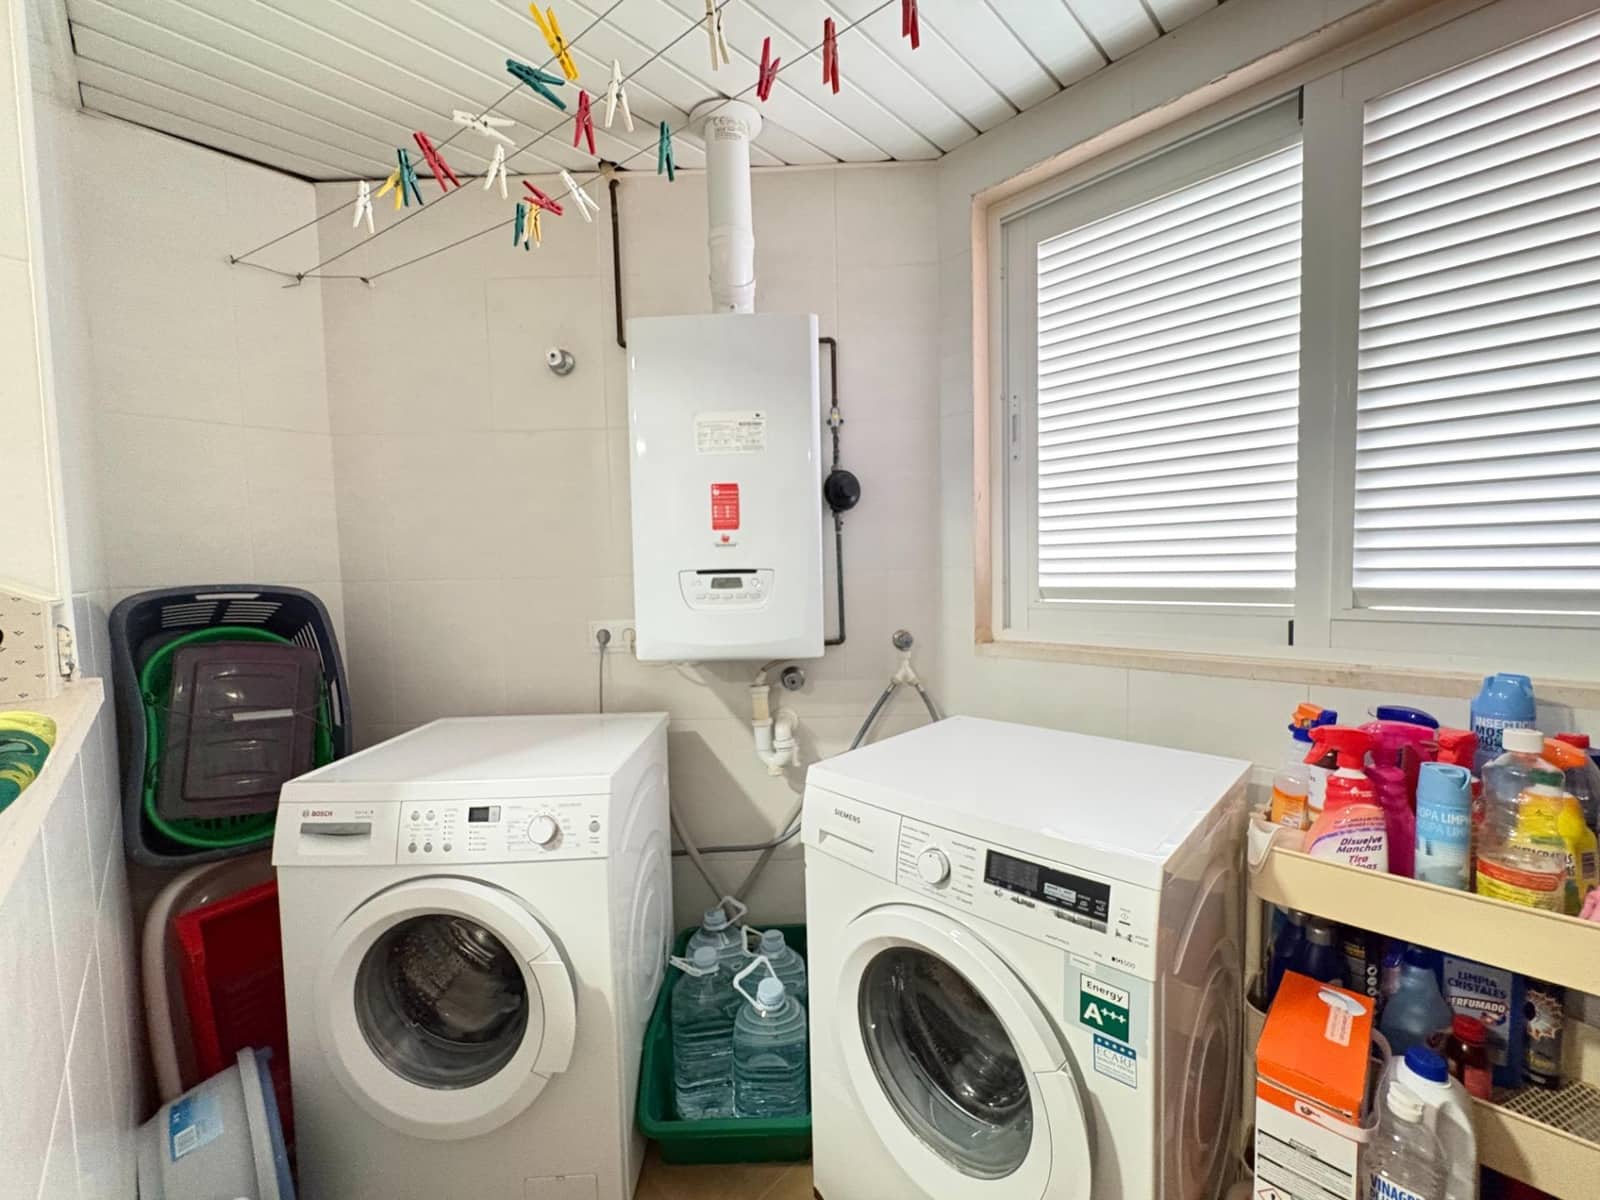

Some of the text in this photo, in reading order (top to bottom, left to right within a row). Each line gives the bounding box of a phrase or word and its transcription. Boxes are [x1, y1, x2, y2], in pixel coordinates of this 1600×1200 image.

[834, 807, 861, 824] SIEMENS
[1336, 844, 1383, 853] Manchas
[1340, 836, 1383, 846] Disuelve
[1447, 977, 1506, 999] CRISTALES
[1458, 971, 1497, 988] LIMPIA
[1086, 980, 1123, 1002] Energy
[1083, 1002, 1127, 1026] A+++
[1370, 1173, 1421, 1200] VINAG
